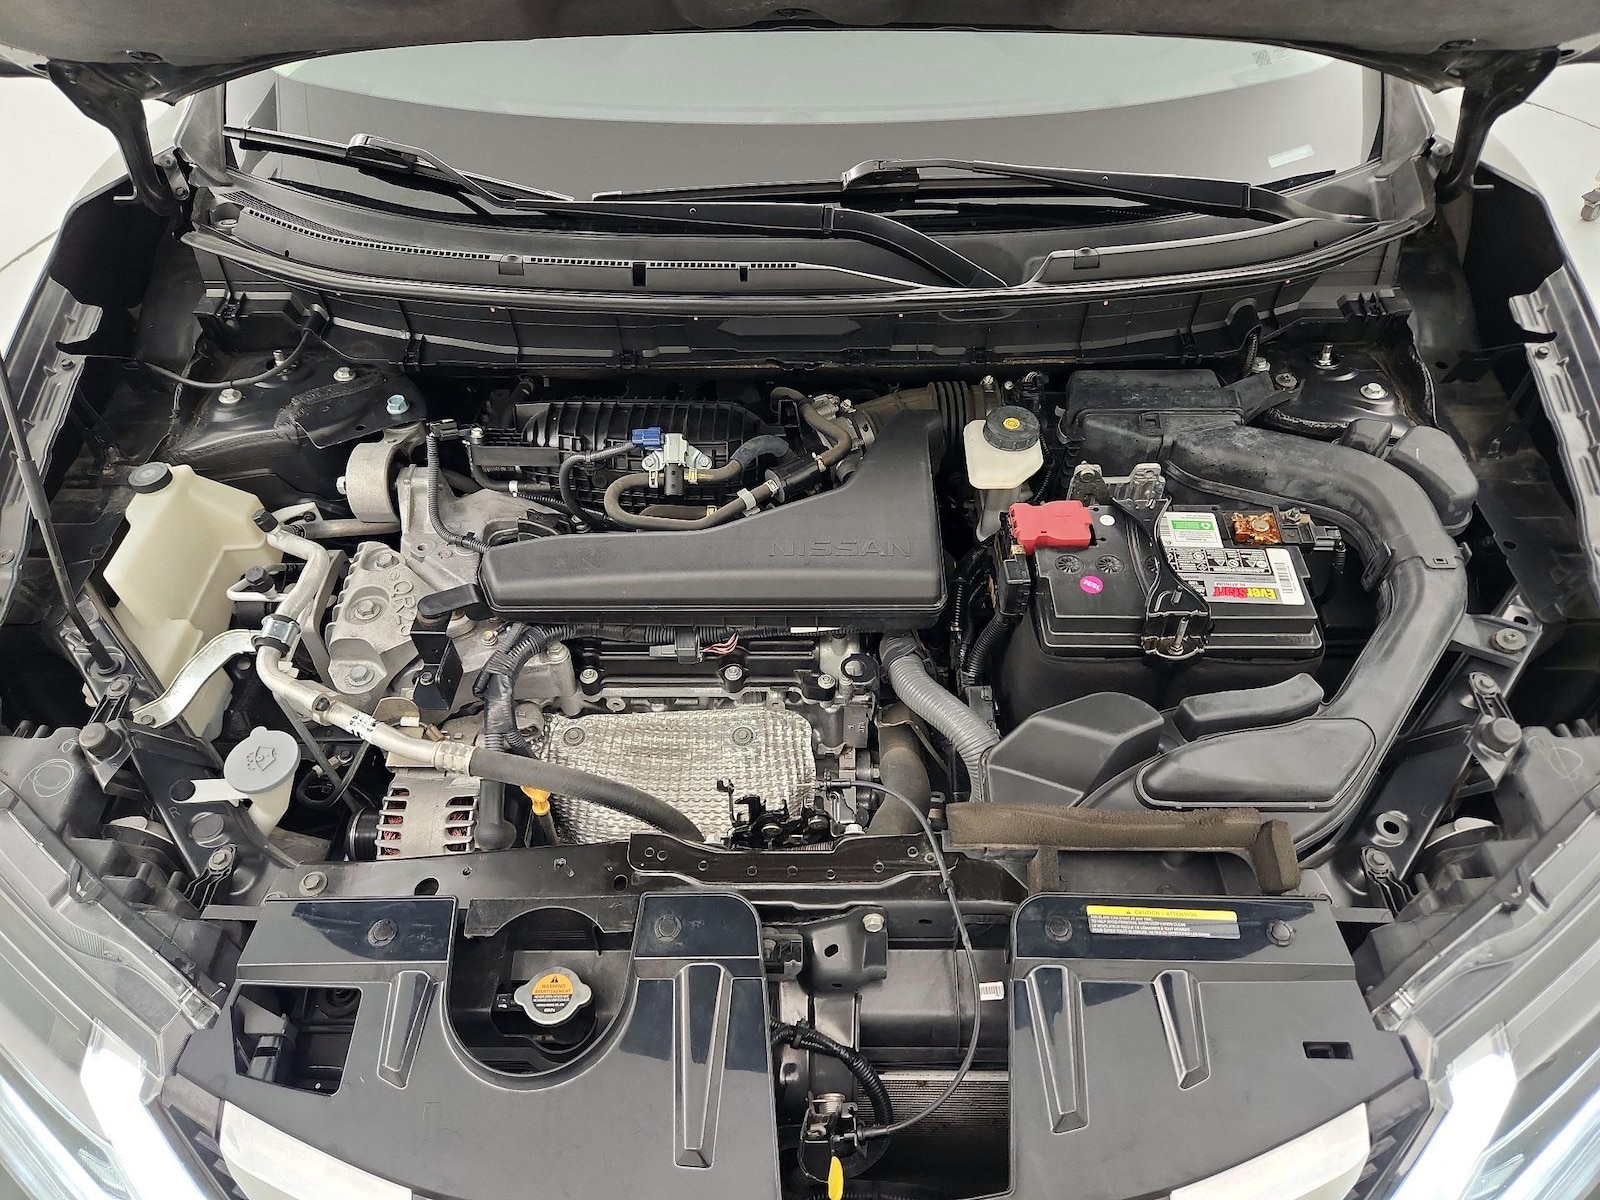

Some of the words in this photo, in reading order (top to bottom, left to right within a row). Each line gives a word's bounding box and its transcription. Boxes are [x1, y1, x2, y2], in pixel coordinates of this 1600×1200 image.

[769, 538, 914, 557] NISSAN
[1212, 586, 1277, 600] EverStart
[168, 806, 181, 819] R
